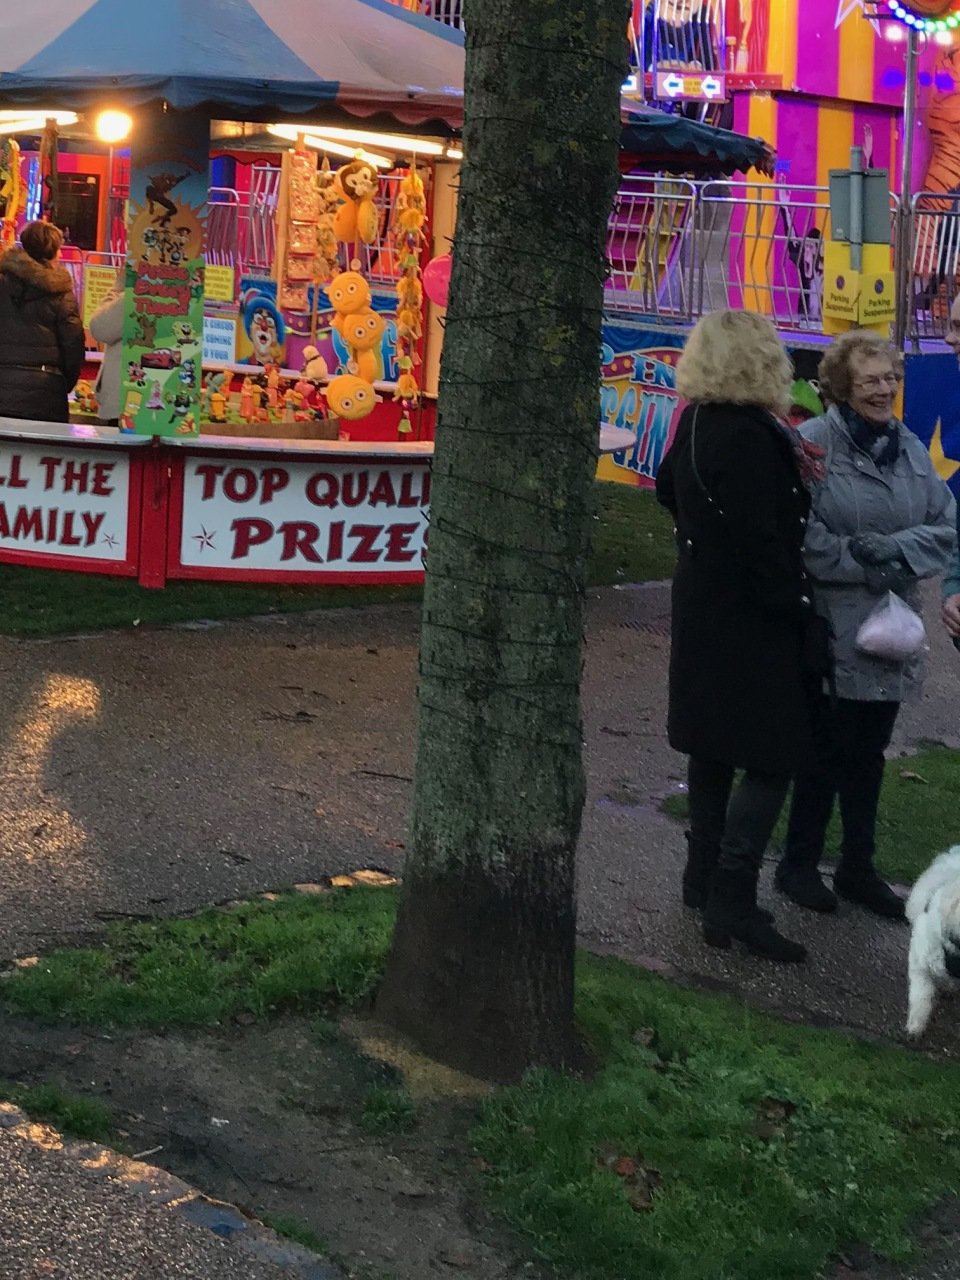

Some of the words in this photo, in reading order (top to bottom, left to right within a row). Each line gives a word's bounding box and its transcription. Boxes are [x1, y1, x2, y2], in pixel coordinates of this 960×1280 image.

[39, 456, 116, 497] THE
[195, 464, 290, 506] TOP
[305, 470, 431, 510] QUALI
[230, 517, 429, 563] PRIZE
